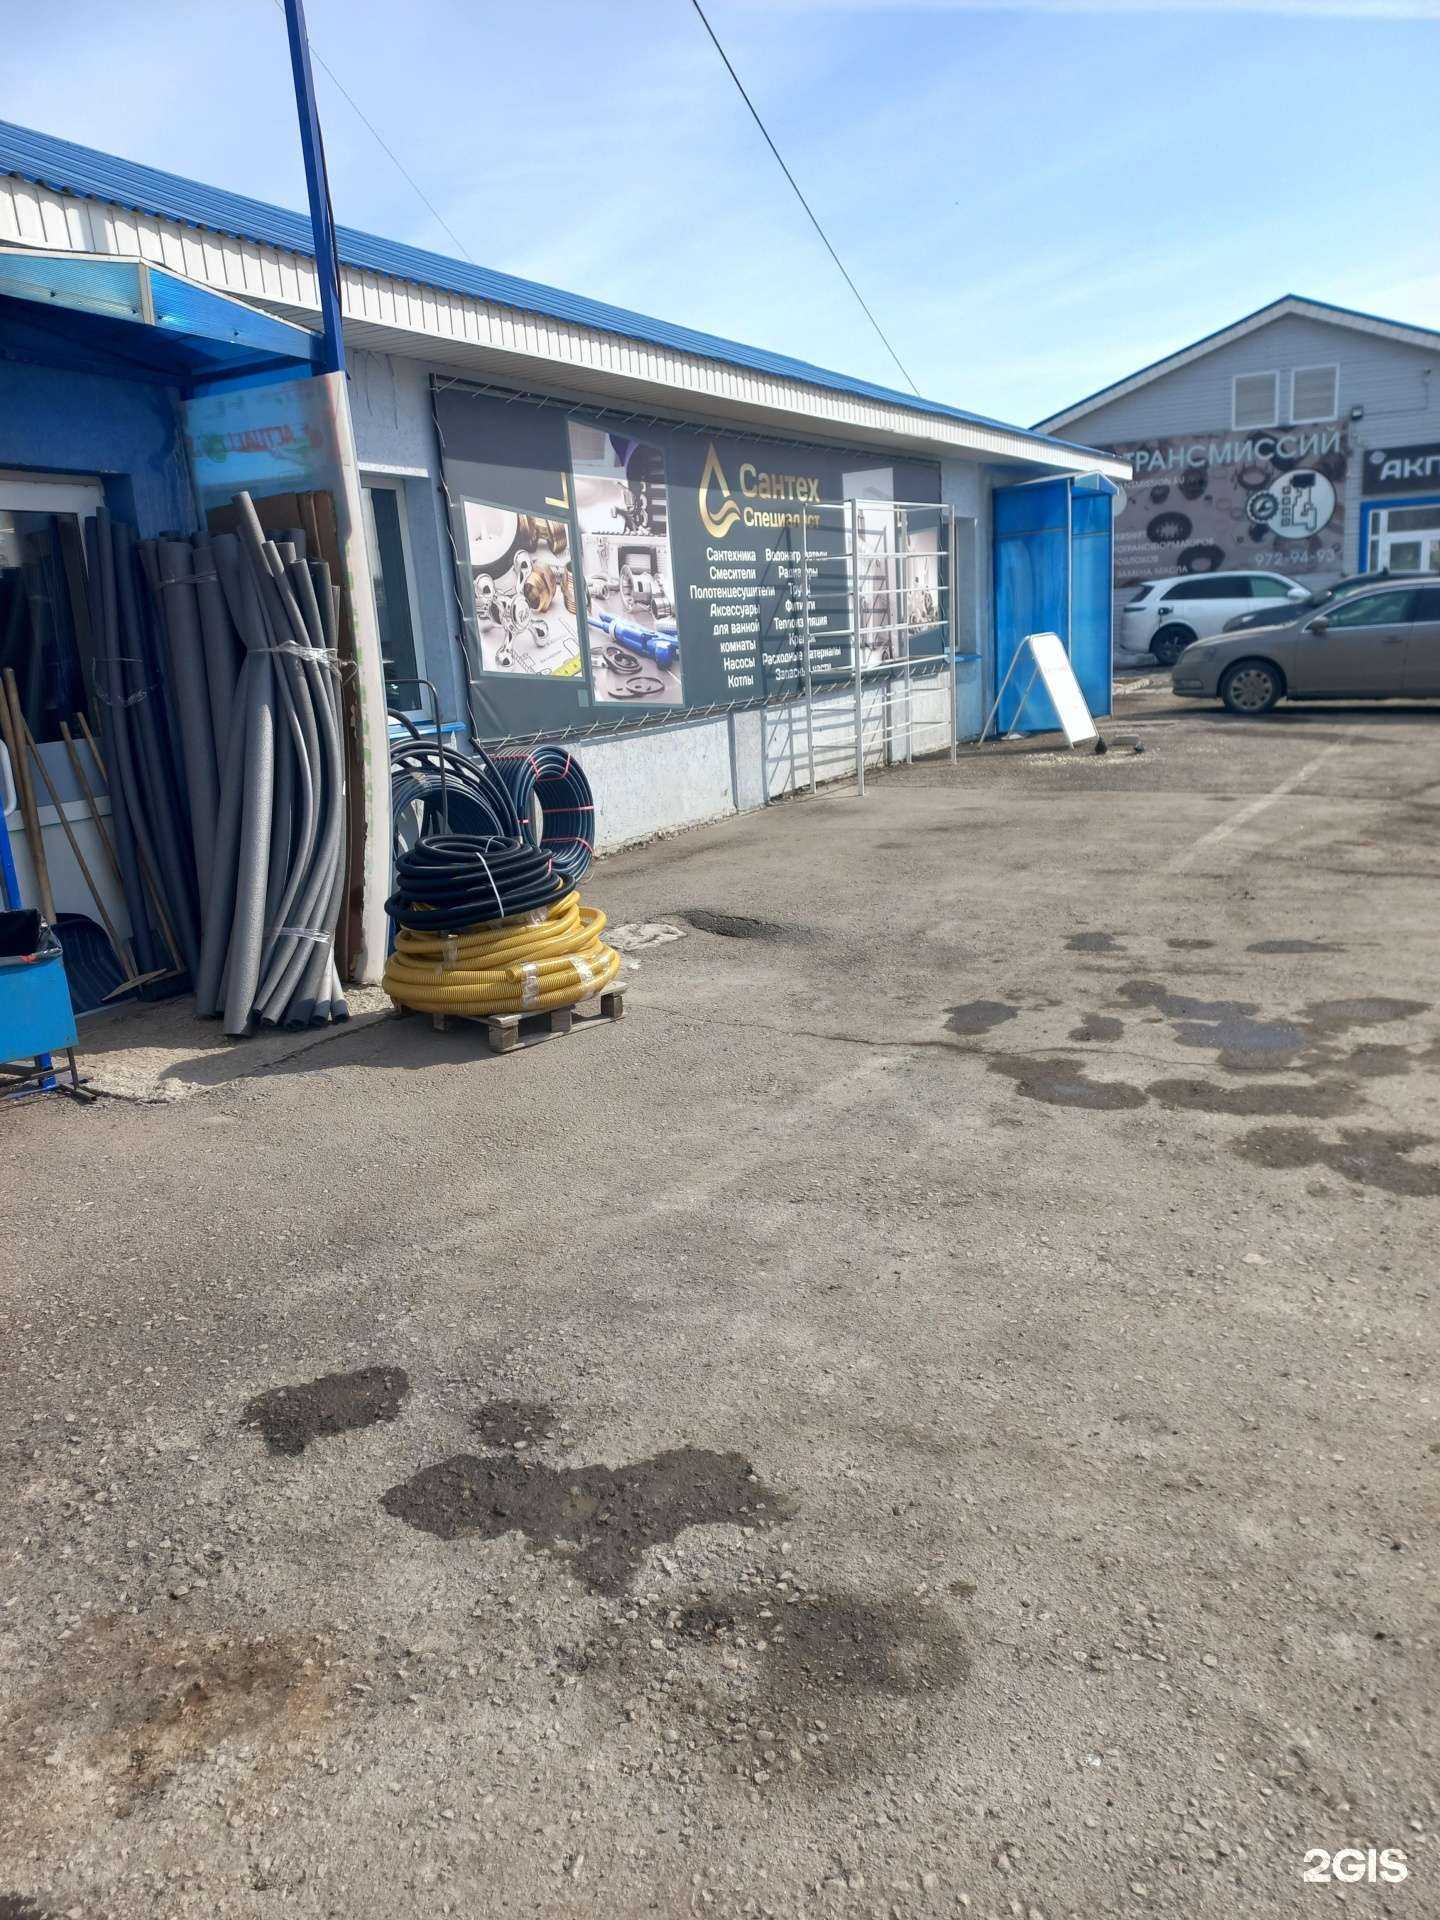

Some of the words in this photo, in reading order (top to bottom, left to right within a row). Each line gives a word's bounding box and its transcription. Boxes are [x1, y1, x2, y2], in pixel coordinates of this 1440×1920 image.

[740, 463, 820, 502] Сантех
[743, 506, 821, 528] Специалст
[706, 547, 757, 562] Сантехника
[765, 548, 828, 563] Водонагрватели
[709, 566, 756, 580] Смесители
[778, 565, 819, 580] Радиары
[689, 584, 776, 600] Полотенцесушители
[710, 603, 761, 618] Аксессуары
[785, 599, 816, 613] Фитиги
[713, 624, 729, 635] для
[731, 619, 760, 634] ванной
[773, 616, 828, 630] Теплоизляция
[720, 638, 756, 653] комнаты
[807, 645, 842, 661] атериалы
[724, 657, 755, 671] Насосы
[728, 674, 754, 688] Котлы
